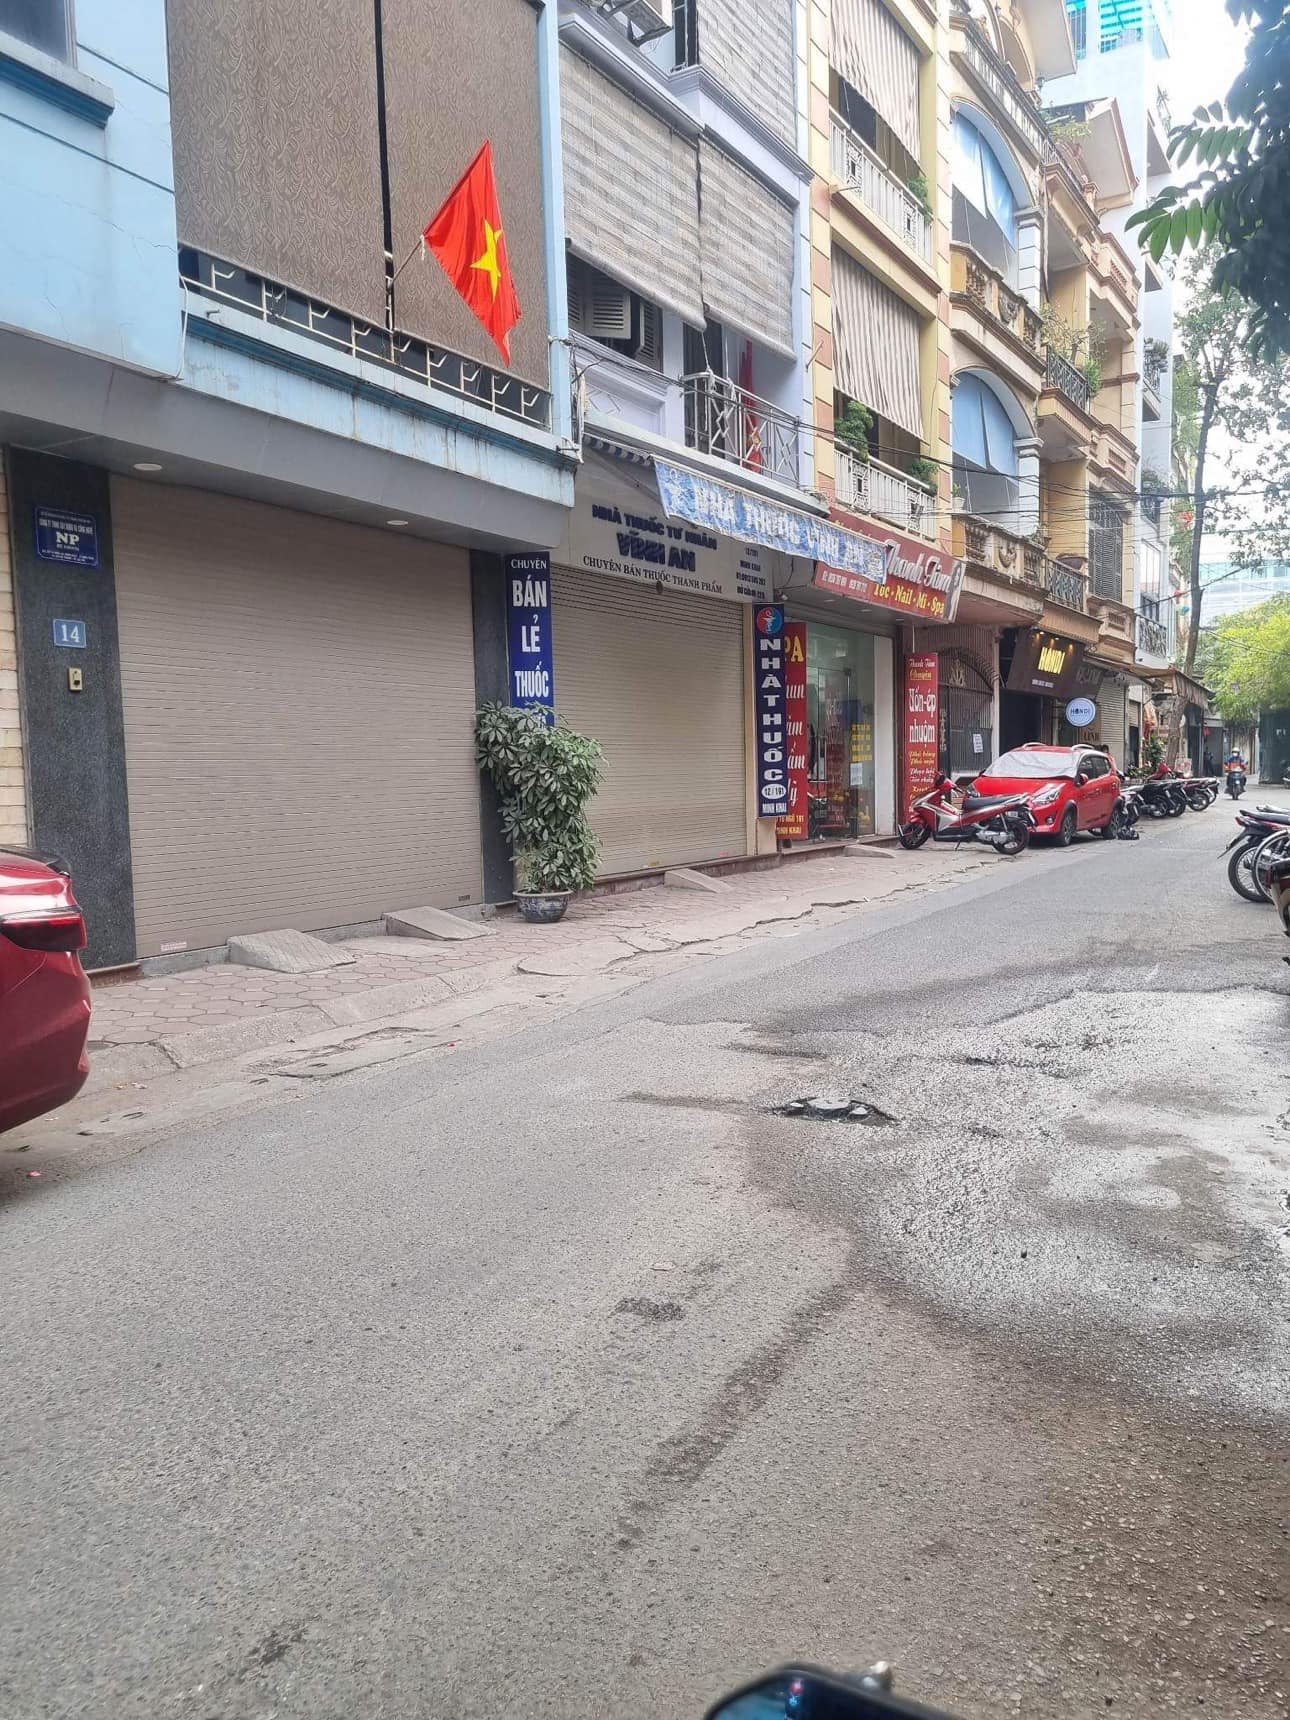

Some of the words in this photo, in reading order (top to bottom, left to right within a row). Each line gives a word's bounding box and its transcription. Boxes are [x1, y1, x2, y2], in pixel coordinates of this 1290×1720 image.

[592, 504, 622, 525] NHÀ
[623, 513, 665, 536] THUỐC
[56, 531, 80, 546] NP
[511, 557, 548, 570] CHUYÊN
[583, 554, 621, 573] CHUYÊN
[623, 564, 642, 577] BÁN
[643, 568, 671, 583] THUỐC
[667, 546, 696, 572] AN
[512, 574, 548, 608] BÁN
[894, 584, 914, 606] Nail
[930, 596, 946, 618] Spa
[61, 623, 80, 643] 14
[521, 614, 541, 653] LẺ
[784, 635, 804, 662] PA
[514, 660, 549, 698] THUỐC
